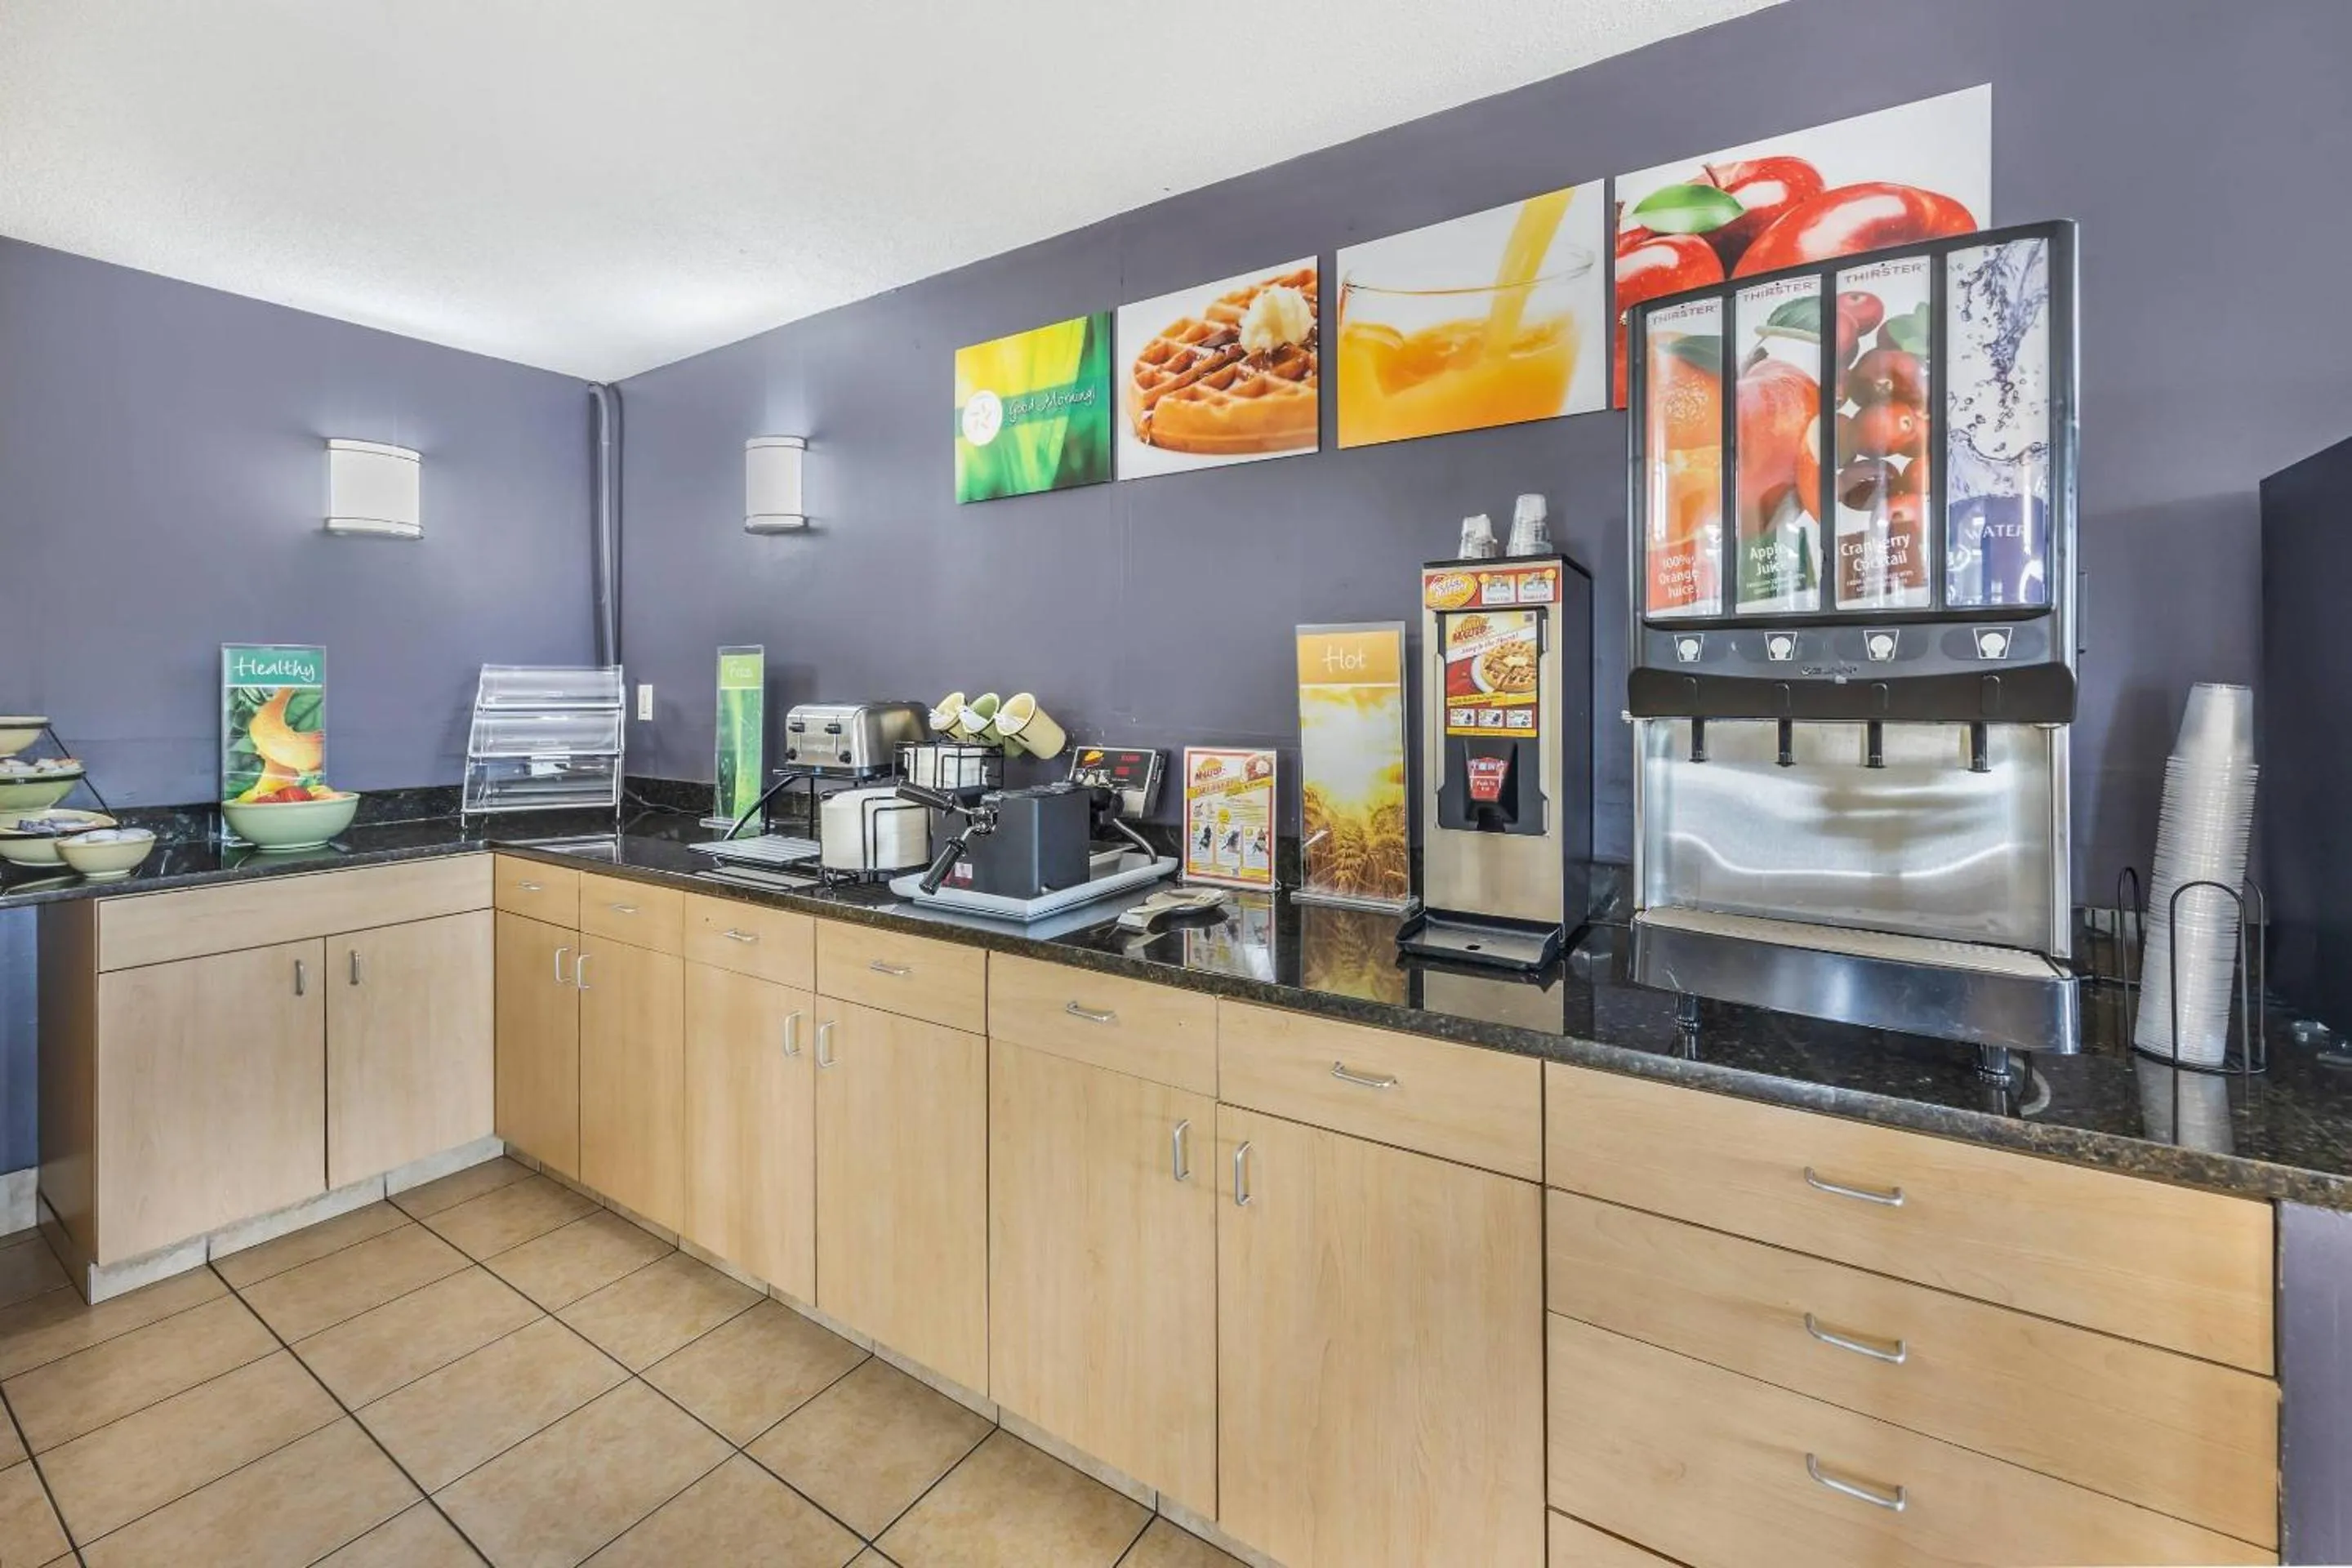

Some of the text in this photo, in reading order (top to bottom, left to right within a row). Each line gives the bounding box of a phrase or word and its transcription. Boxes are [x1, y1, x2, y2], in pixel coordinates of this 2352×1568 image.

[1844, 265, 1922, 283] THIRSTER
[1744, 283, 1812, 302] THIRSTER
[1652, 305, 1714, 325] THIRSTER
[1008, 398, 1036, 423] Good
[234, 656, 315, 682] Healthy
[1322, 642, 1366, 674] Hot
